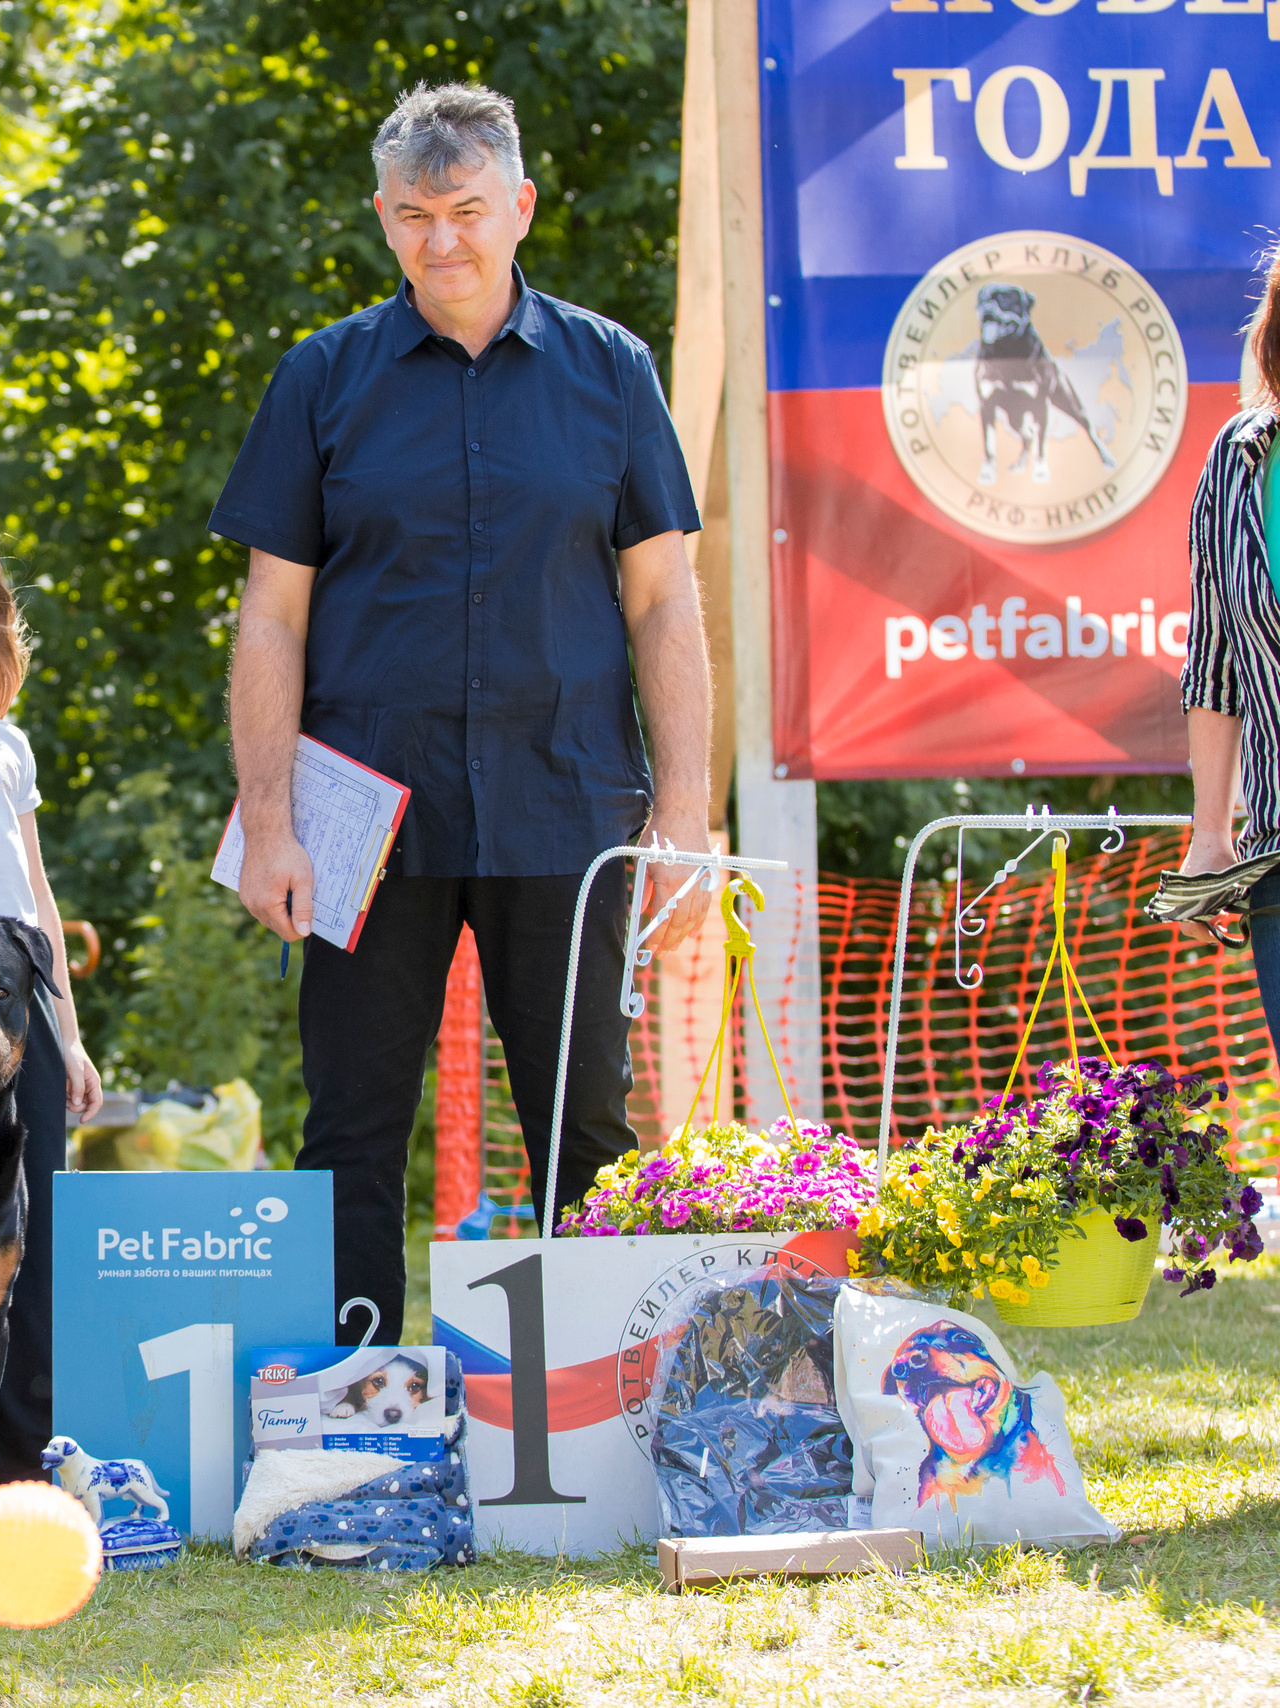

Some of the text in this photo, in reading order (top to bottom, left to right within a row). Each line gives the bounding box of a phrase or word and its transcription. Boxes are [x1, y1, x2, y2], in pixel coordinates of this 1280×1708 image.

[892, 65, 1271, 196] ГОДА
[896, 244, 1177, 456] РОТВЕЙЛЕР КЛУБ РОССИИ
[884, 596, 1190, 679] petfabric
[97, 1228, 272, 1261] Pet Fabric
[97, 1267, 273, 1280] умная забота о ваших питомцах
[257, 1367, 297, 1381] TRIXIE
[467, 1253, 587, 1507] 1
[622, 1254, 717, 1440] РОТВЕЙЛЕР
[138, 1323, 234, 1543] 1
[257, 1408, 310, 1434] Tammy
